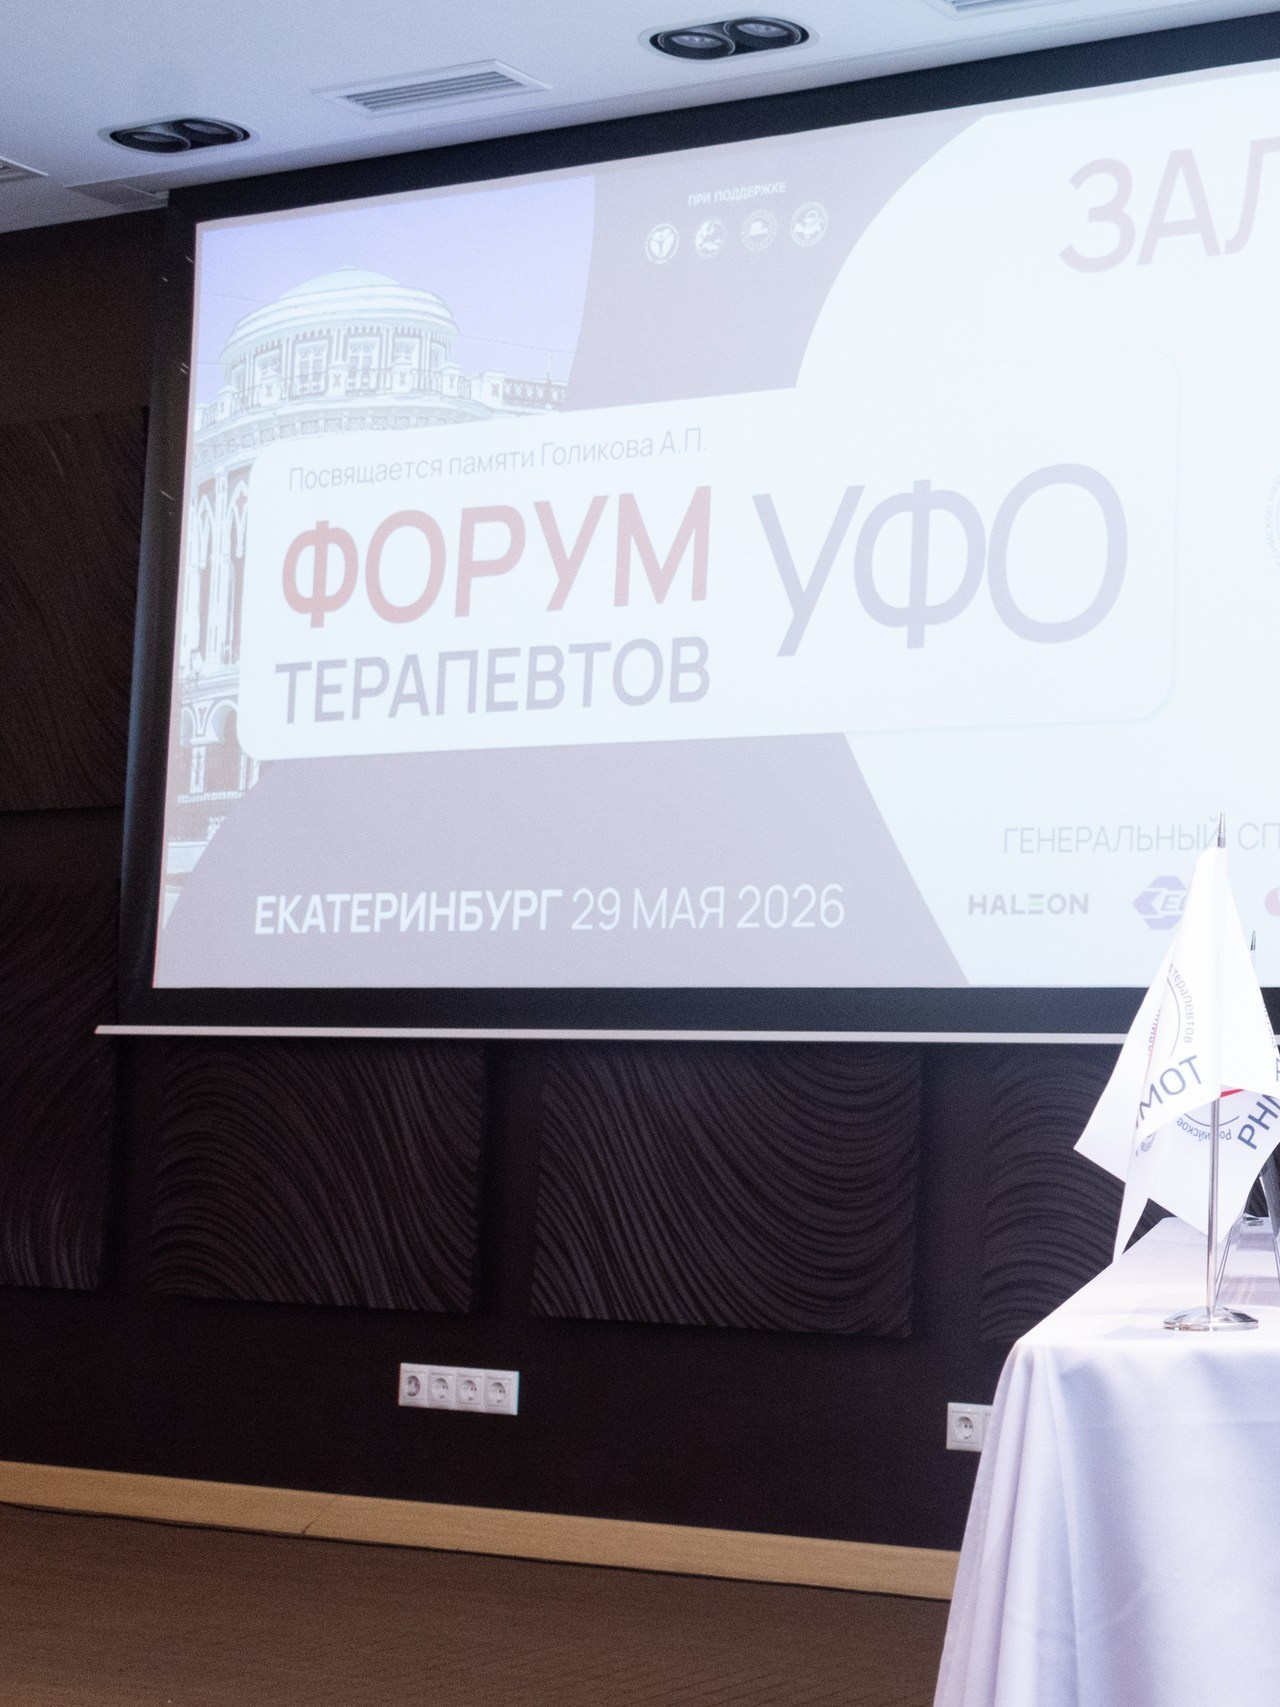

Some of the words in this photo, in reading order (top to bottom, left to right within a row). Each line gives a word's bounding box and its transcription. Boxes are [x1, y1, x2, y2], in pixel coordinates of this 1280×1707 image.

[688, 191, 711, 207] ПРИ
[714, 181, 787, 204] ПОДДЕРЖКЕ
[288, 456, 443, 493] Посвящается
[448, 445, 535, 480] памяти
[540, 430, 654, 470] Голикова
[658, 426, 708, 457] А.П.
[282, 486, 712, 628] ФОРУМ
[751, 463, 1129, 657] УФО
[275, 636, 712, 724] ТЕРАПЕВТОВ
[1003, 815, 1219, 854] ГЕНЕРАЛЬНЫЙ
[254, 888, 563, 935] ЕКАТЕРИНБУРГ
[571, 886, 621, 931] 29
[633, 886, 725, 931] МАЯ
[737, 882, 846, 930] 2026
[968, 892, 1089, 916] HALEON
[1176, 1117, 1232, 1142] Роийское
